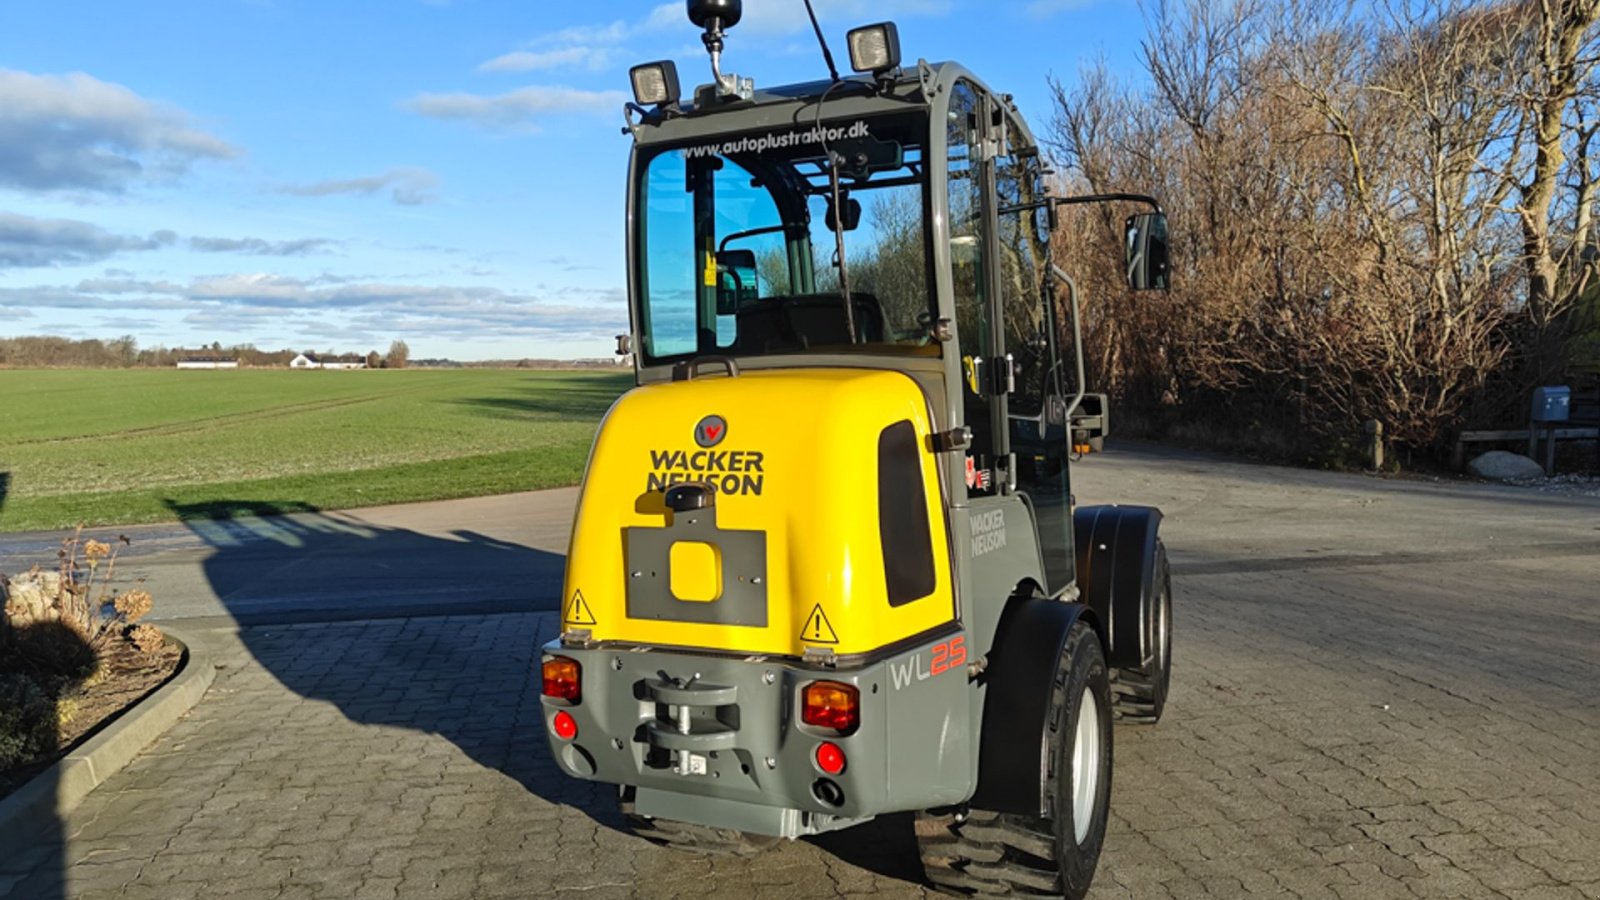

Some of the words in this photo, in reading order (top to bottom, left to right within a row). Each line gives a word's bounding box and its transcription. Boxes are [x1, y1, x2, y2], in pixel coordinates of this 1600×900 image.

[650, 450, 764, 472] WACKER
[970, 509, 1005, 536] WACKER
[971, 528, 1006, 558] NEUSON
